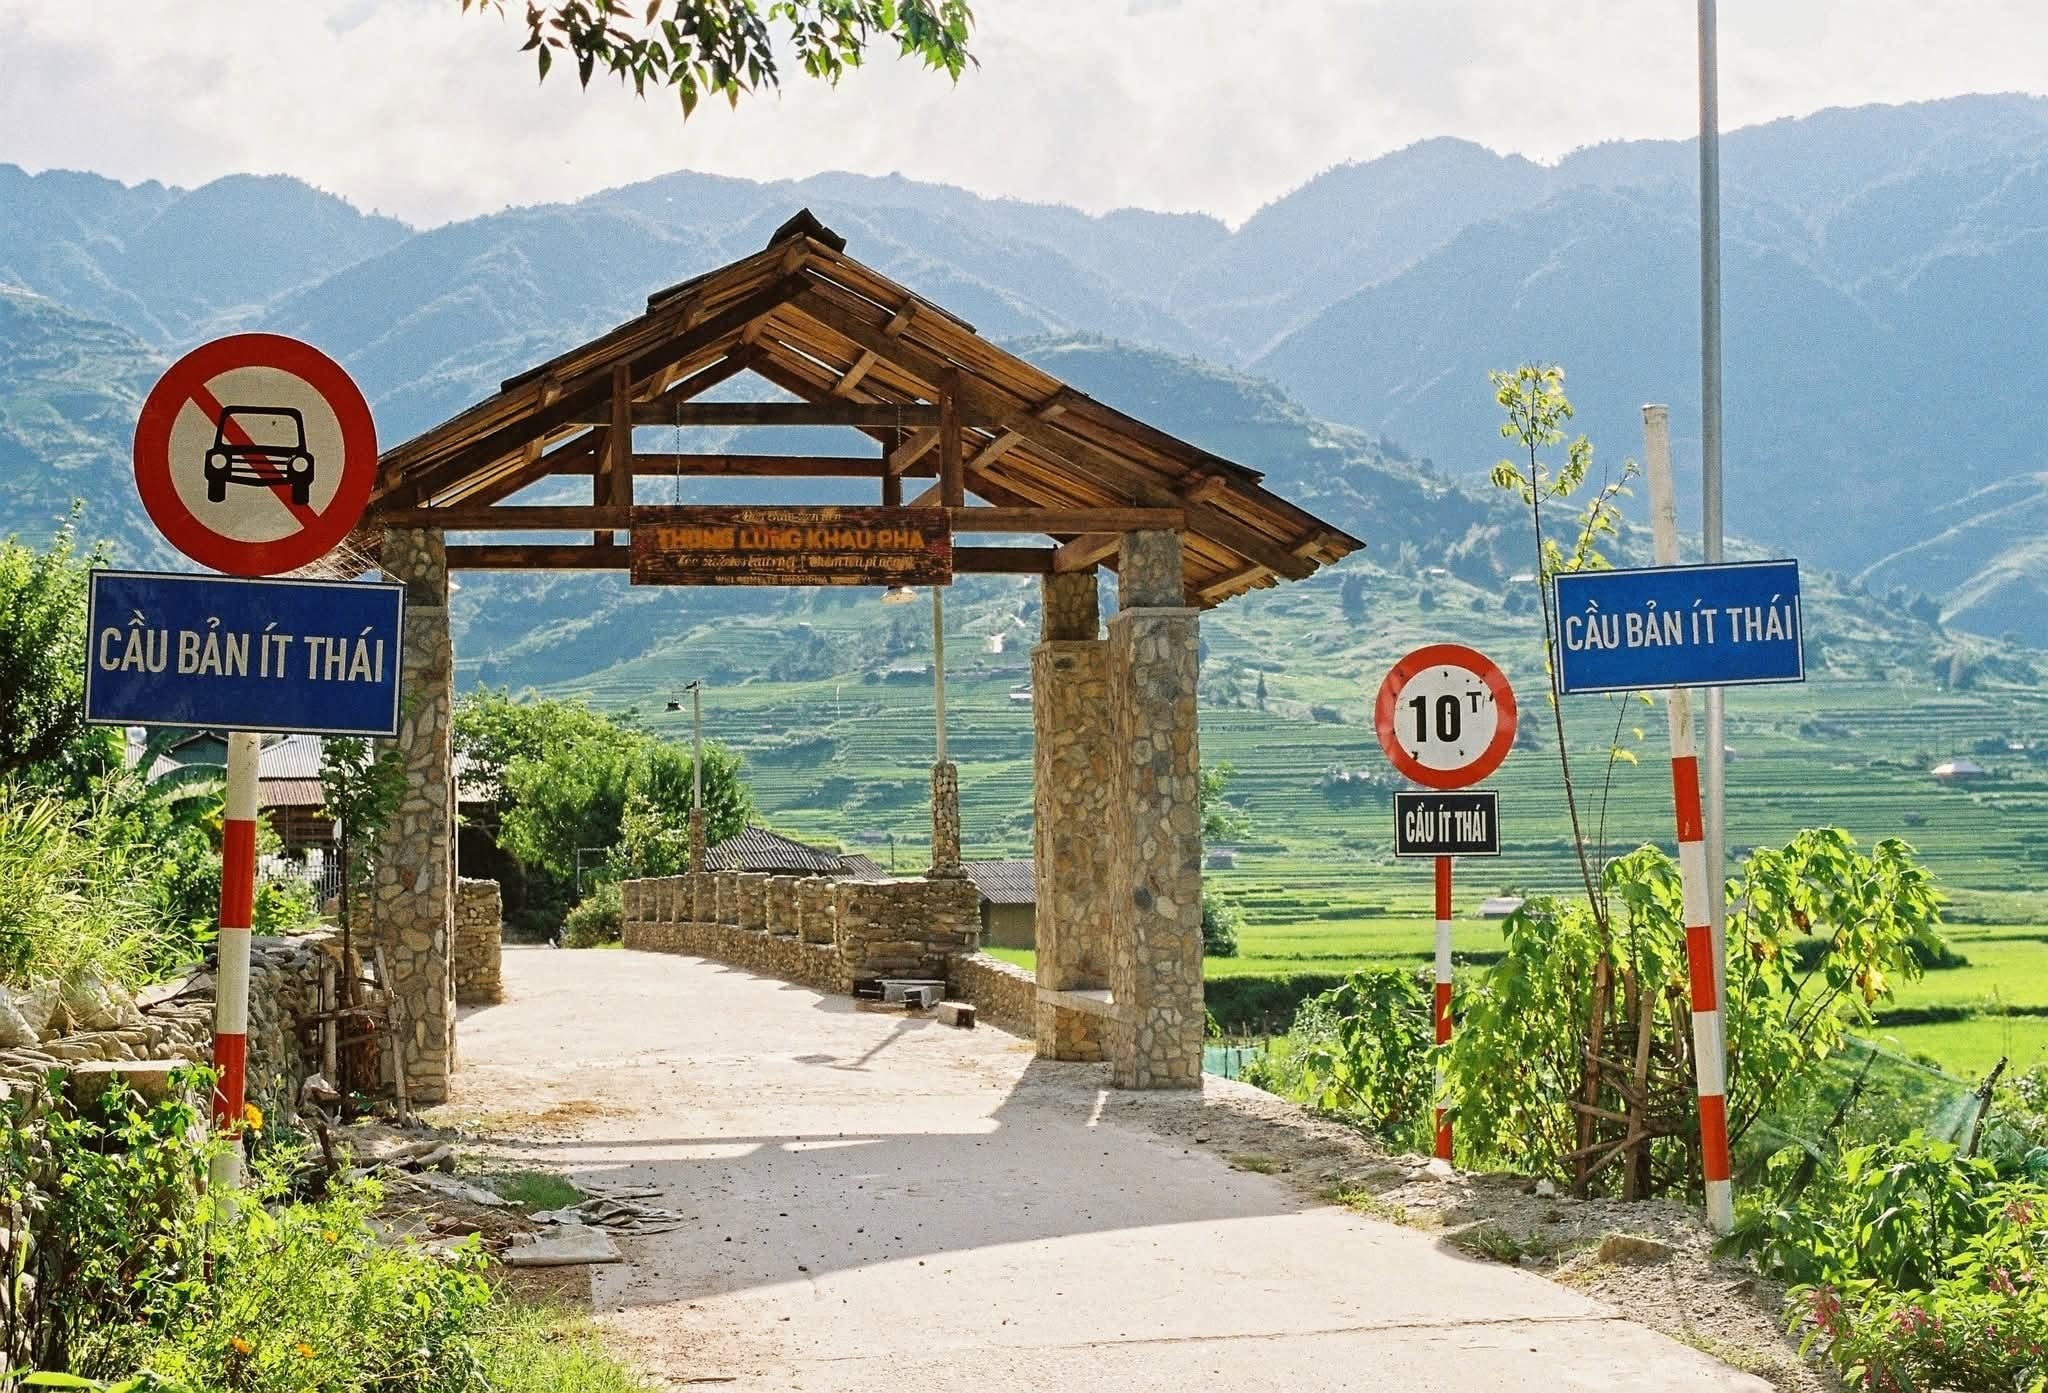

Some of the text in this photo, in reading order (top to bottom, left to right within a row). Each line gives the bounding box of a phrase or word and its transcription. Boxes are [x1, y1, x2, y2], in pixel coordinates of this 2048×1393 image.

[807, 529, 873, 549] KHAU
[877, 529, 926, 549] PHA
[99, 608, 384, 683] CẦU BẢN ÍT THÁI
[1566, 594, 1793, 651] CẦU BẢN ÍT THÁI
[1405, 802, 1488, 843] CẦU ÍT THÁI
